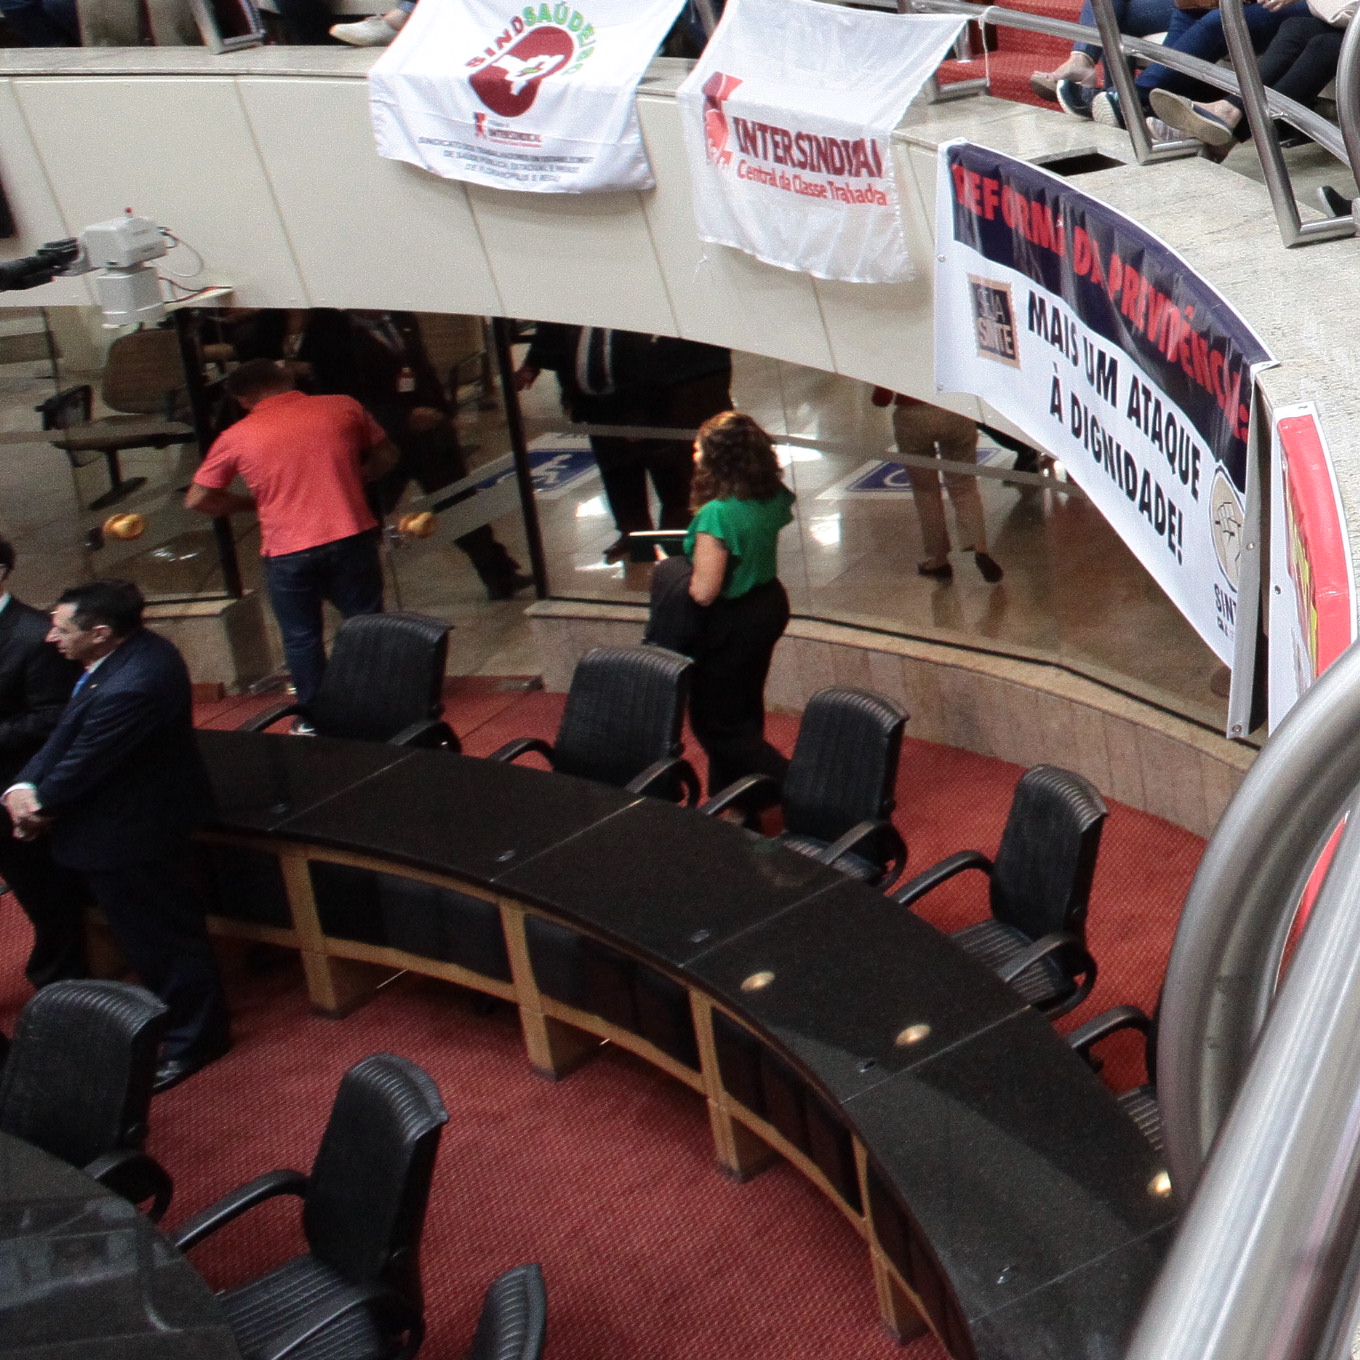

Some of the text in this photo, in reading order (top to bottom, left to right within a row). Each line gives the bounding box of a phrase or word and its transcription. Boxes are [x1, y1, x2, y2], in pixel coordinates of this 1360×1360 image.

[737, 159, 777, 188] Central
[779, 171, 791, 192] da
[792, 173, 827, 200] Classe
[1028, 289, 1201, 502] MAIS UM ATAQUE
[1050, 361, 1183, 567] À DIGNIDADE!
